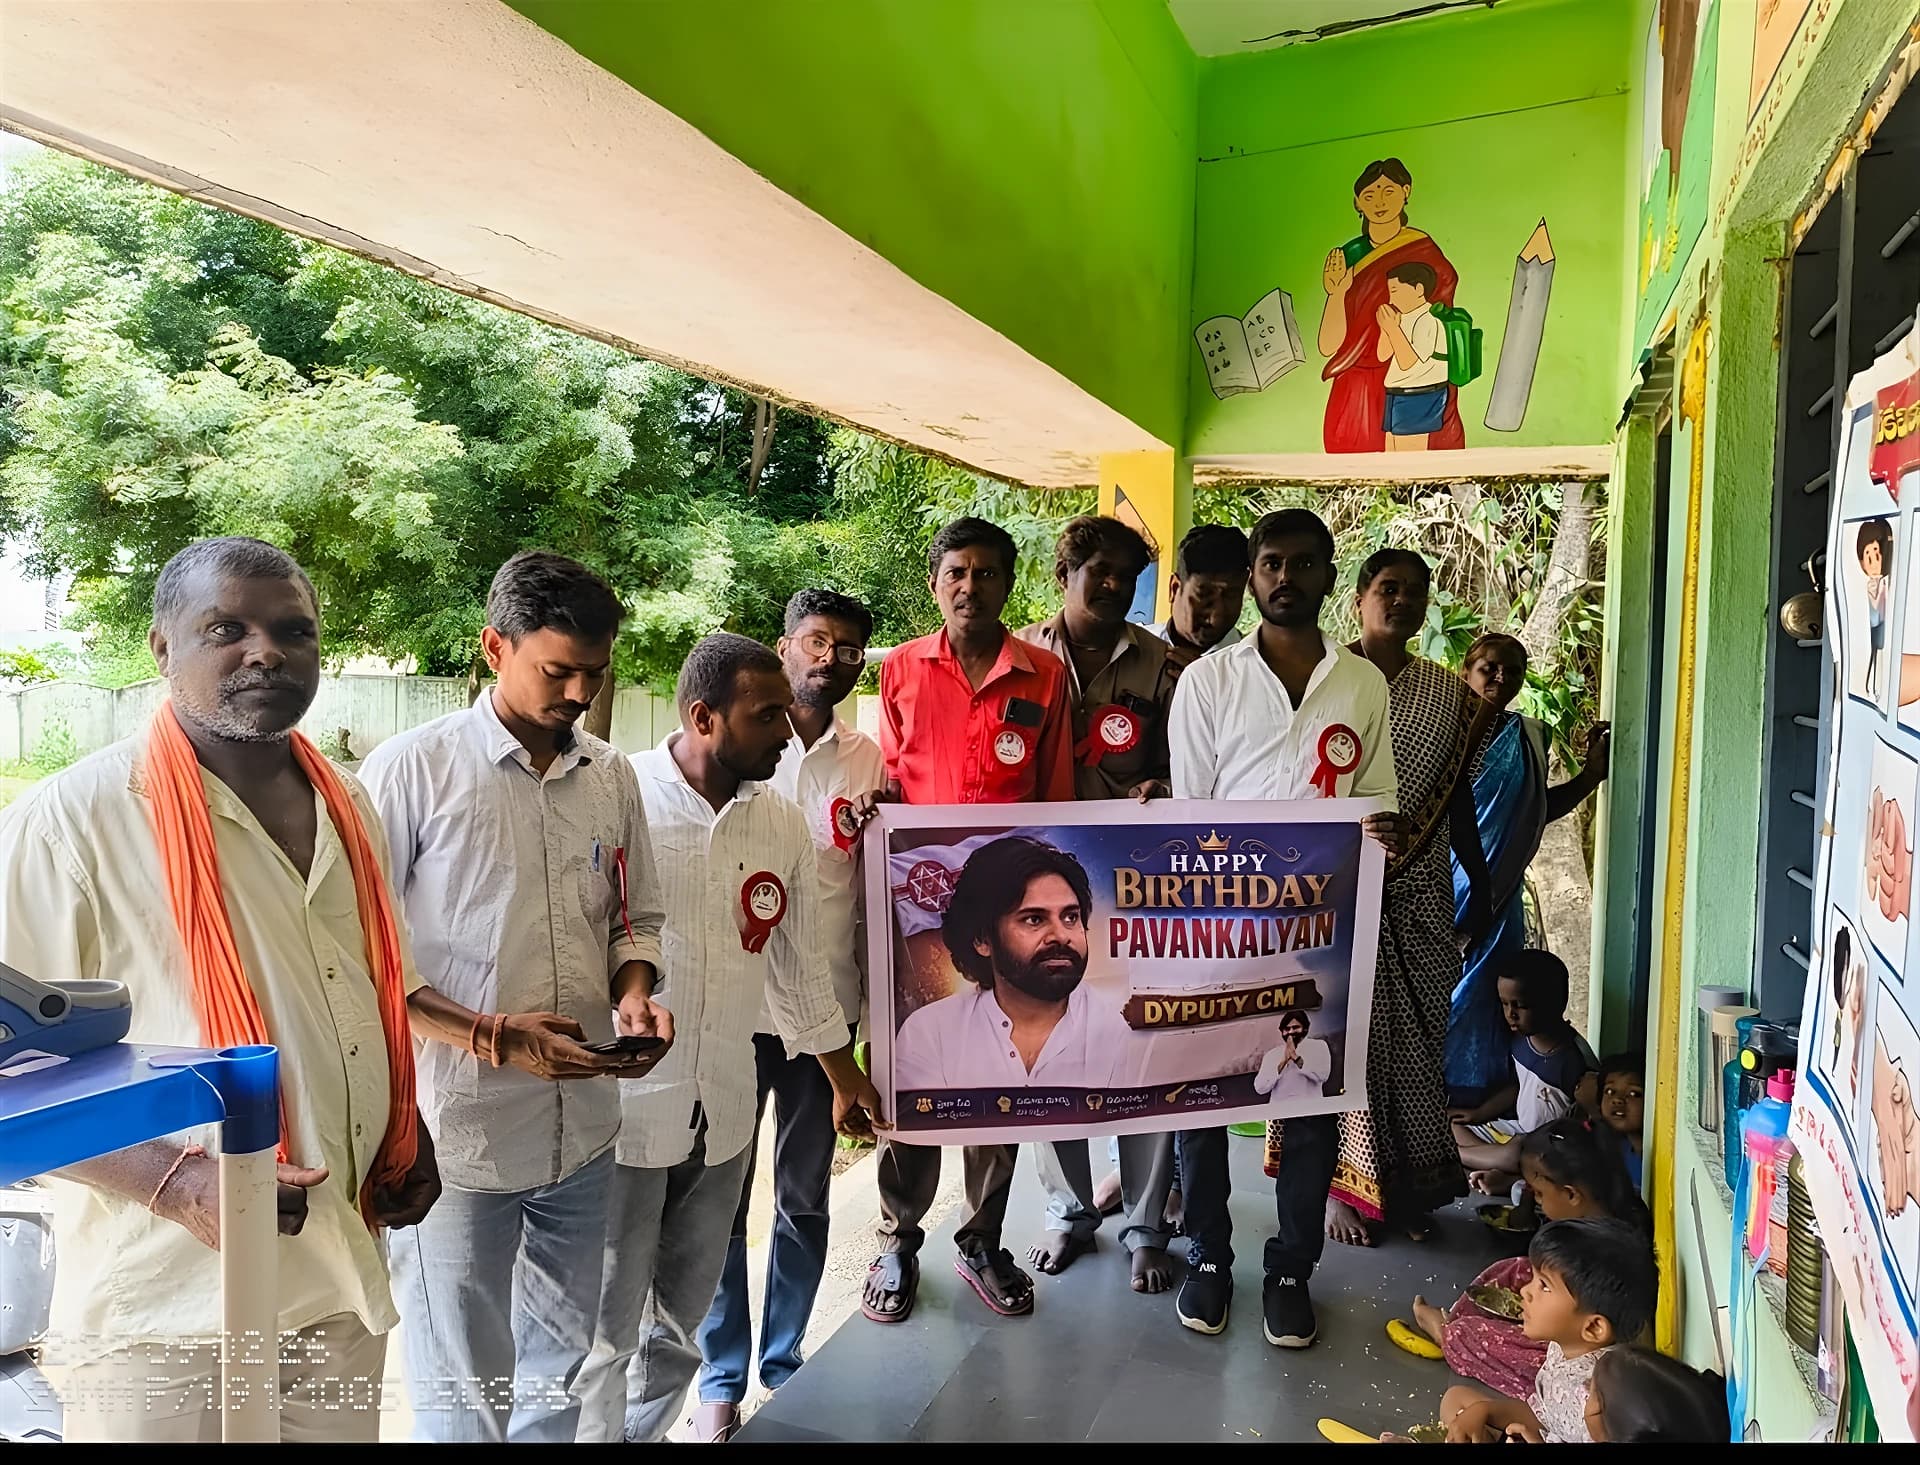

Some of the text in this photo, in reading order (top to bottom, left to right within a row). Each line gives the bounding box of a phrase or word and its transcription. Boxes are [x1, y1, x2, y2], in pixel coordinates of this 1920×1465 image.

[1258, 325, 1276, 339] C D
[1254, 342, 1272, 358] E F
[1170, 854, 1268, 873] HAPPY
[1113, 867, 1334, 909] BIRTHDAY
[1109, 910, 1336, 959] PAVANKALYAN
[1143, 986, 1295, 1025] DYPUTY CM
[1198, 1262, 1217, 1274] AIR
[1278, 1276, 1297, 1287] AIR
